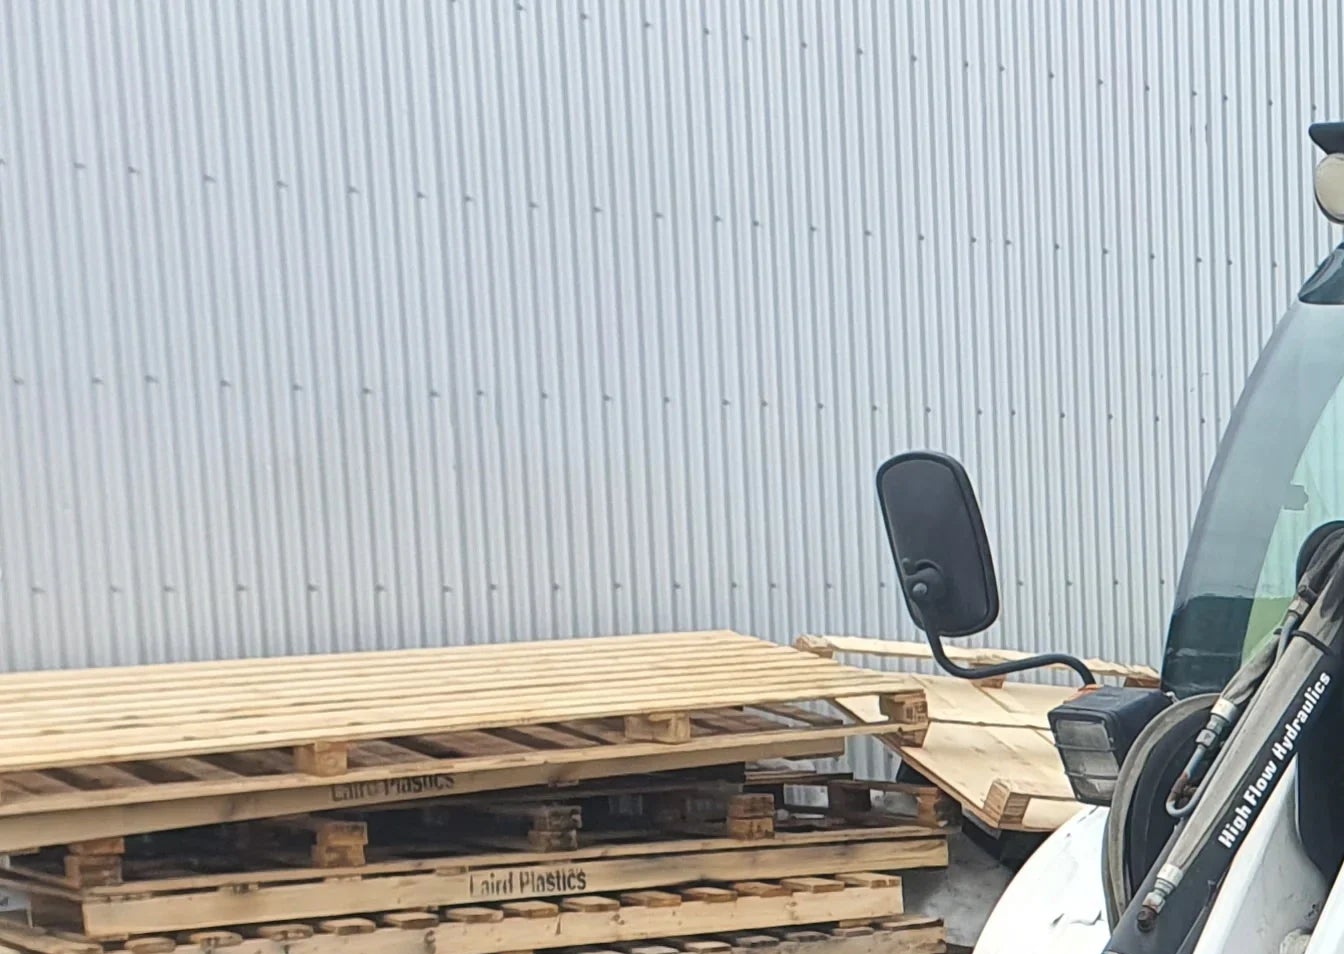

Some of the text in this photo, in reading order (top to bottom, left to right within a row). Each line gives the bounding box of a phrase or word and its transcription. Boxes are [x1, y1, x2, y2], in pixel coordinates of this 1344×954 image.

[1218, 672, 1331, 849] High Flow Hydraulics
[469, 868, 587, 897] Laird Plastics
